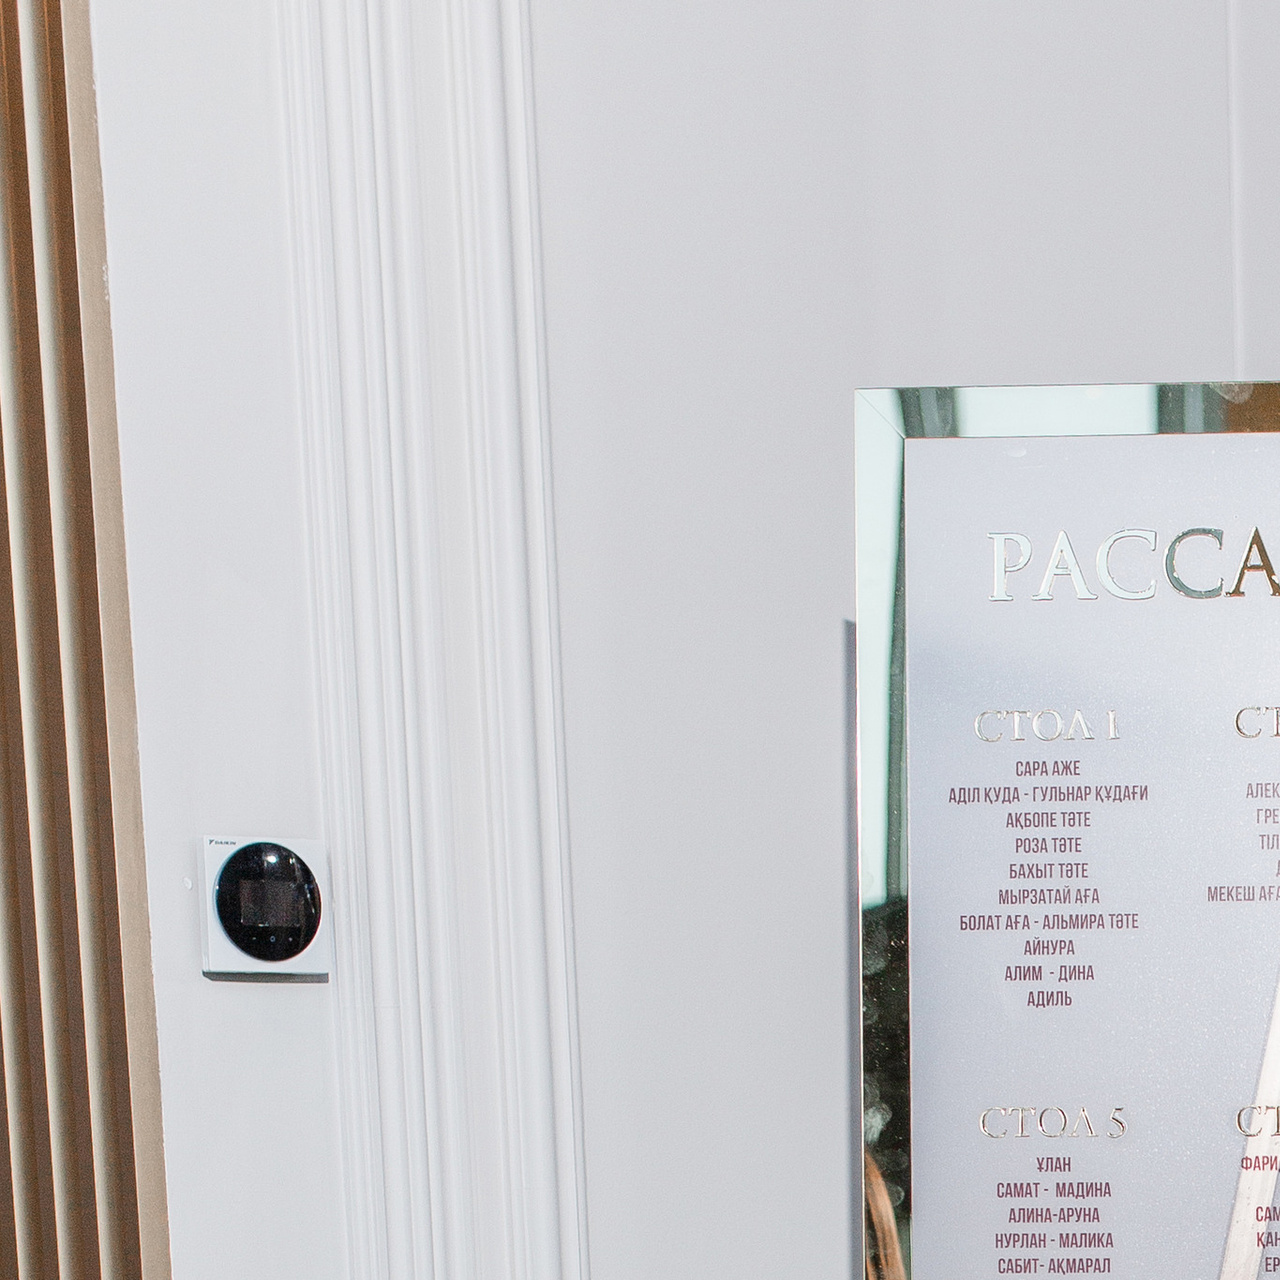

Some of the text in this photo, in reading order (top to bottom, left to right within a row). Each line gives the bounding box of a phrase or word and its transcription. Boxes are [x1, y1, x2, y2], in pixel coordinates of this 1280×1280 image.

[974, 709, 1094, 742] СТОЛ
[1016, 761, 1080, 777] САРА АЖЕ
[1033, 785, 1091, 803] ГУЛЬНАР
[1016, 838, 1048, 853] РОЗА
[1009, 863, 1054, 879] БАХЫТ
[999, 885, 1071, 904] МЫРЗАТАЙ
[960, 914, 1001, 931] БОЛАТ
[1043, 914, 1105, 931] АЛЬМИРА
[1024, 937, 1074, 956] АЙНУРА
[1005, 965, 1094, 982] АЛИМ ДИНА
[1027, 991, 1072, 1008] АДИЛЬ
[979, 1106, 1128, 1138] СТОЛ 5
[997, 1183, 1111, 1199] САМАТ МАДИНА
[995, 1233, 1113, 1248] НУРЛАН МАЛИКА
